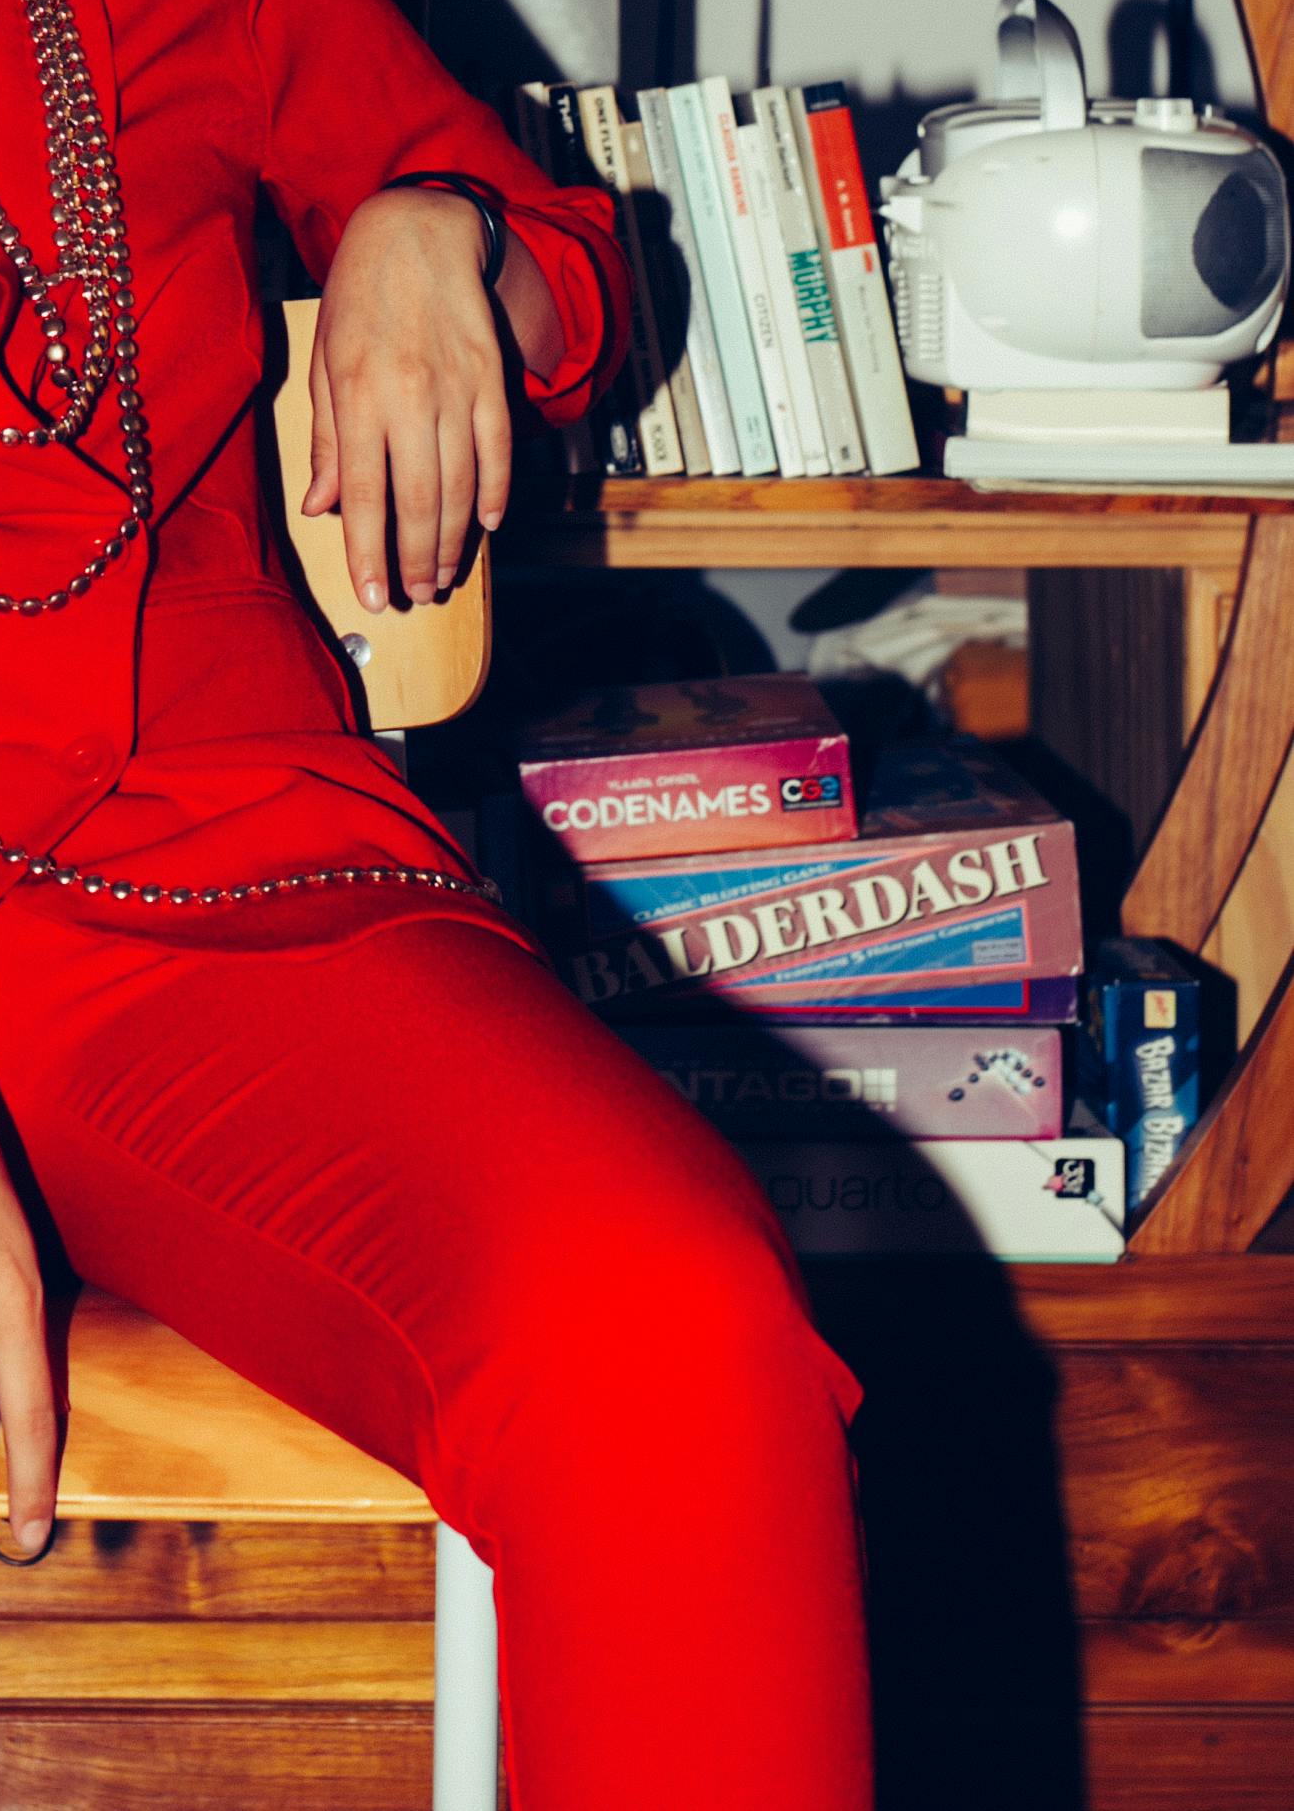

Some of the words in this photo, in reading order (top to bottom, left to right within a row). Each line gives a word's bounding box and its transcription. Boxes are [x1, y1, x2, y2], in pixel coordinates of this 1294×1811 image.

[595, 97, 607, 125] ONE
[601, 128, 613, 166] FLEW
[718, 113, 737, 162] CLAUDIA
[729, 166, 748, 216] RANKINE
[768, 100, 785, 146] Samuel
[779, 146, 795, 192] Beckett
[753, 294, 774, 349] CITIZEN
[789, 248, 839, 344] MURPHY
[542, 783, 772, 832] CODENAMES
[572, 833, 1048, 1004] BALDERDASH
[632, 901, 695, 922] CLASSIC
[700, 877, 781, 906] BLUFFING
[783, 863, 834, 883] GAME
[775, 956, 849, 982] Featuring
[850, 951, 866, 969] 5
[866, 933, 937, 958] Hilarious
[937, 912, 1019, 940] Categories
[1135, 1035, 1175, 1109] BAZAR
[1139, 1115, 1184, 1201] BIZAR
